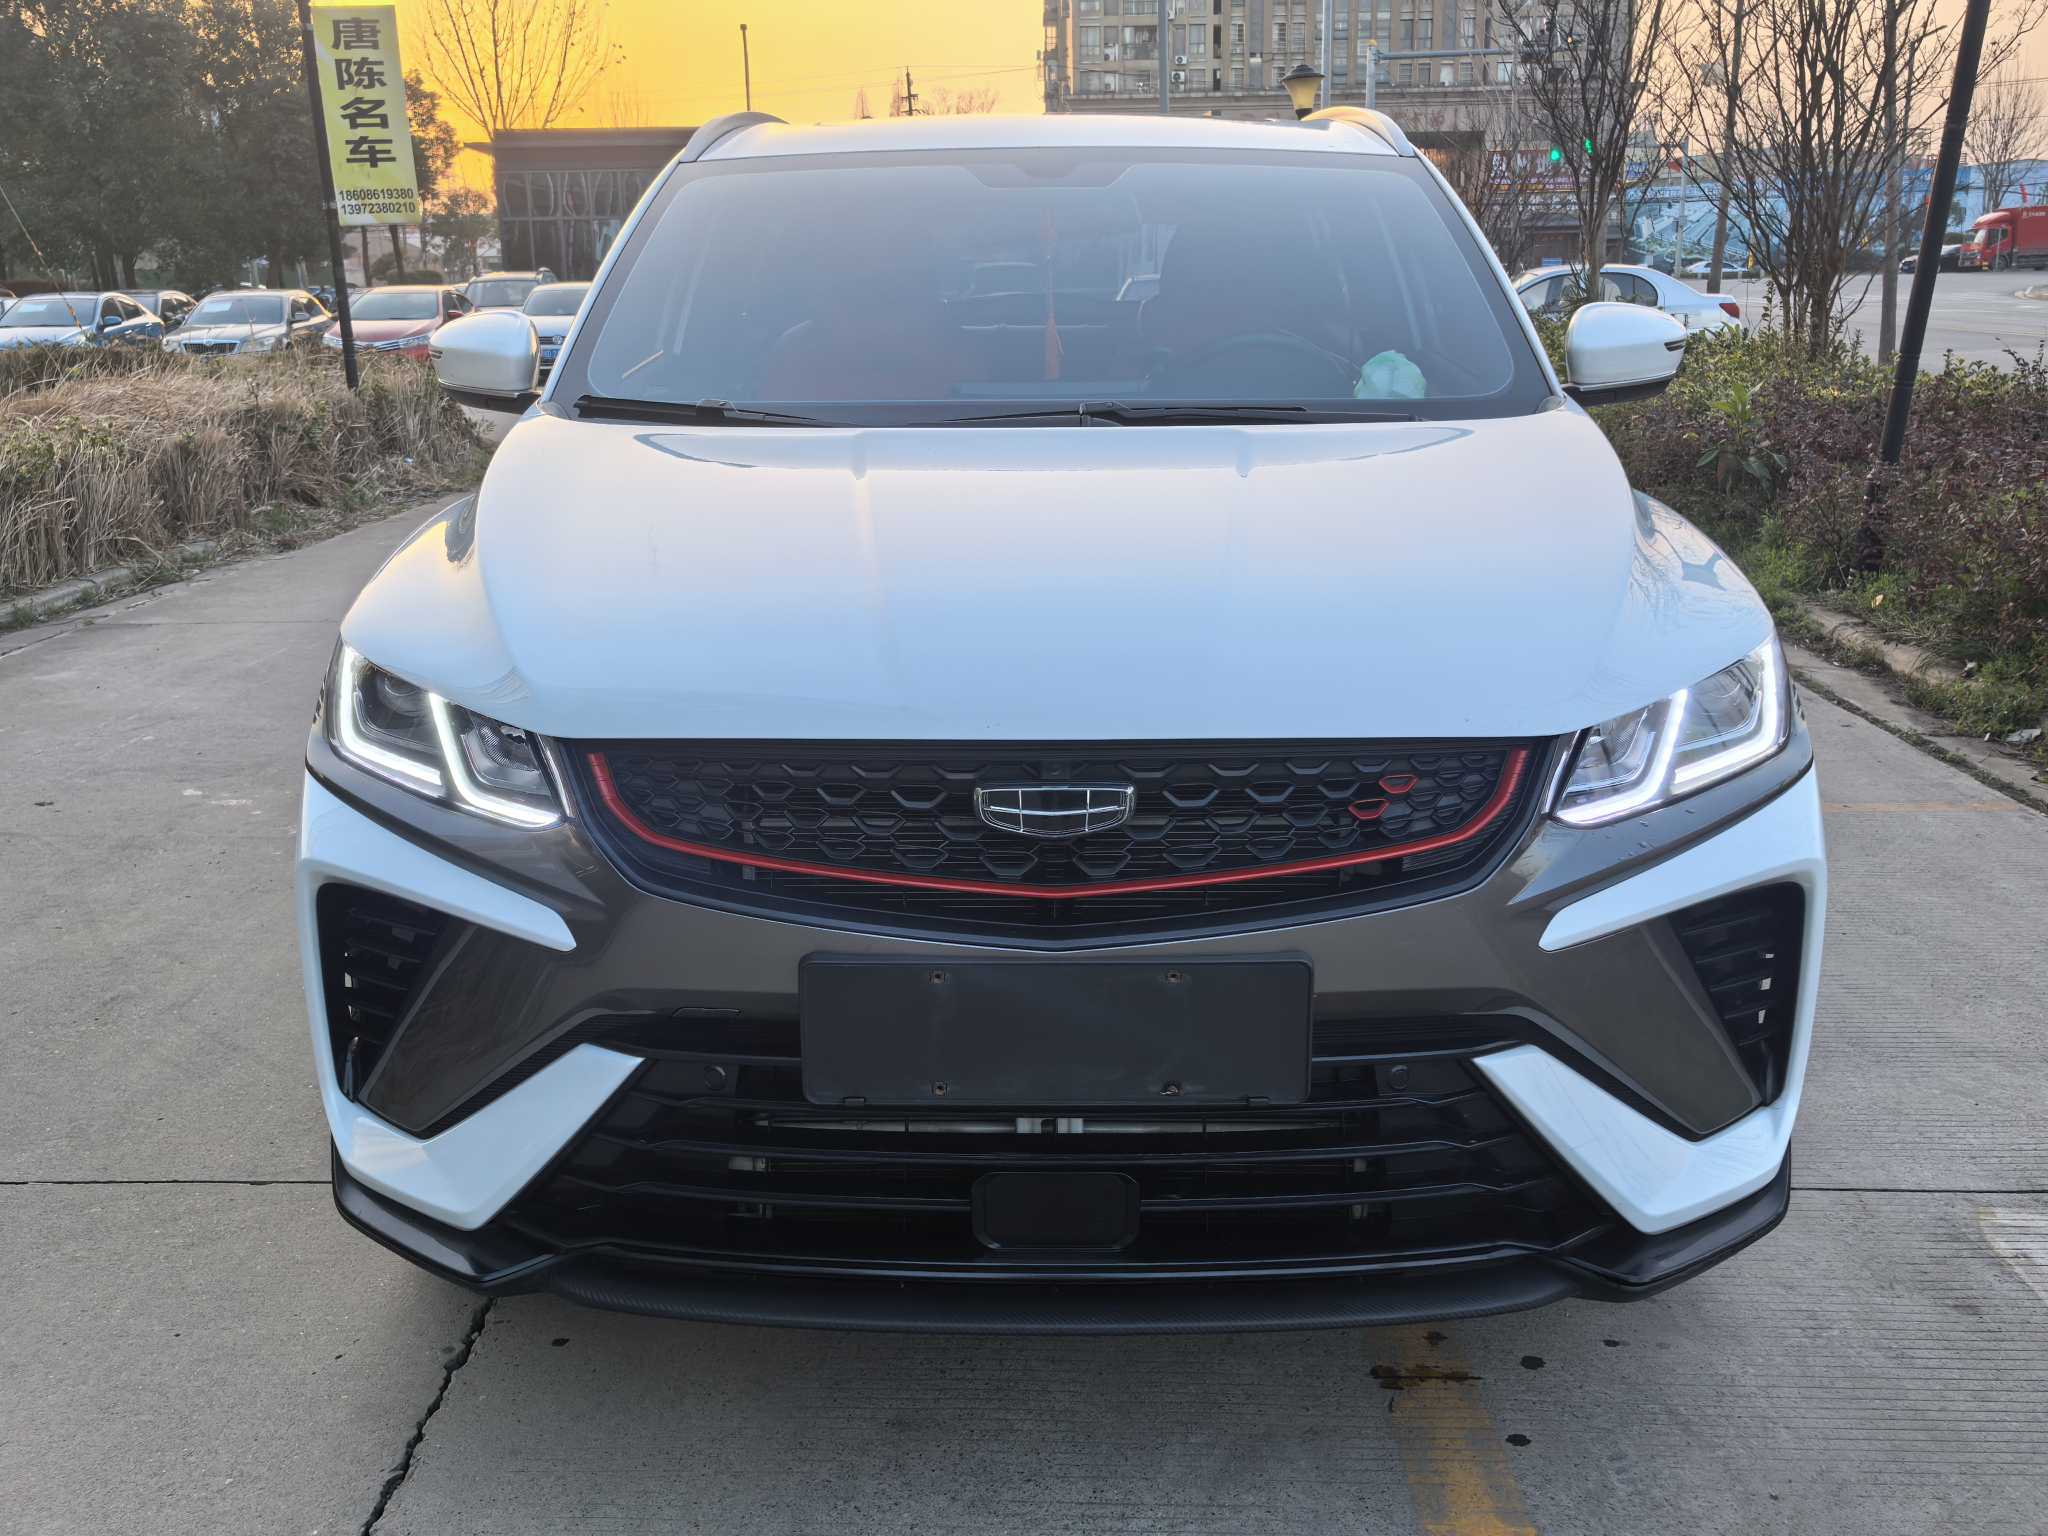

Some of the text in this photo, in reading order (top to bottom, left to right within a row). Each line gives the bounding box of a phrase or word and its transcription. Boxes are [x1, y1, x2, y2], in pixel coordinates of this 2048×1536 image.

[331, 17, 397, 169] 唐陈名车
[339, 188, 414, 201] 18608619380
[341, 202, 416, 215] 13972380210
